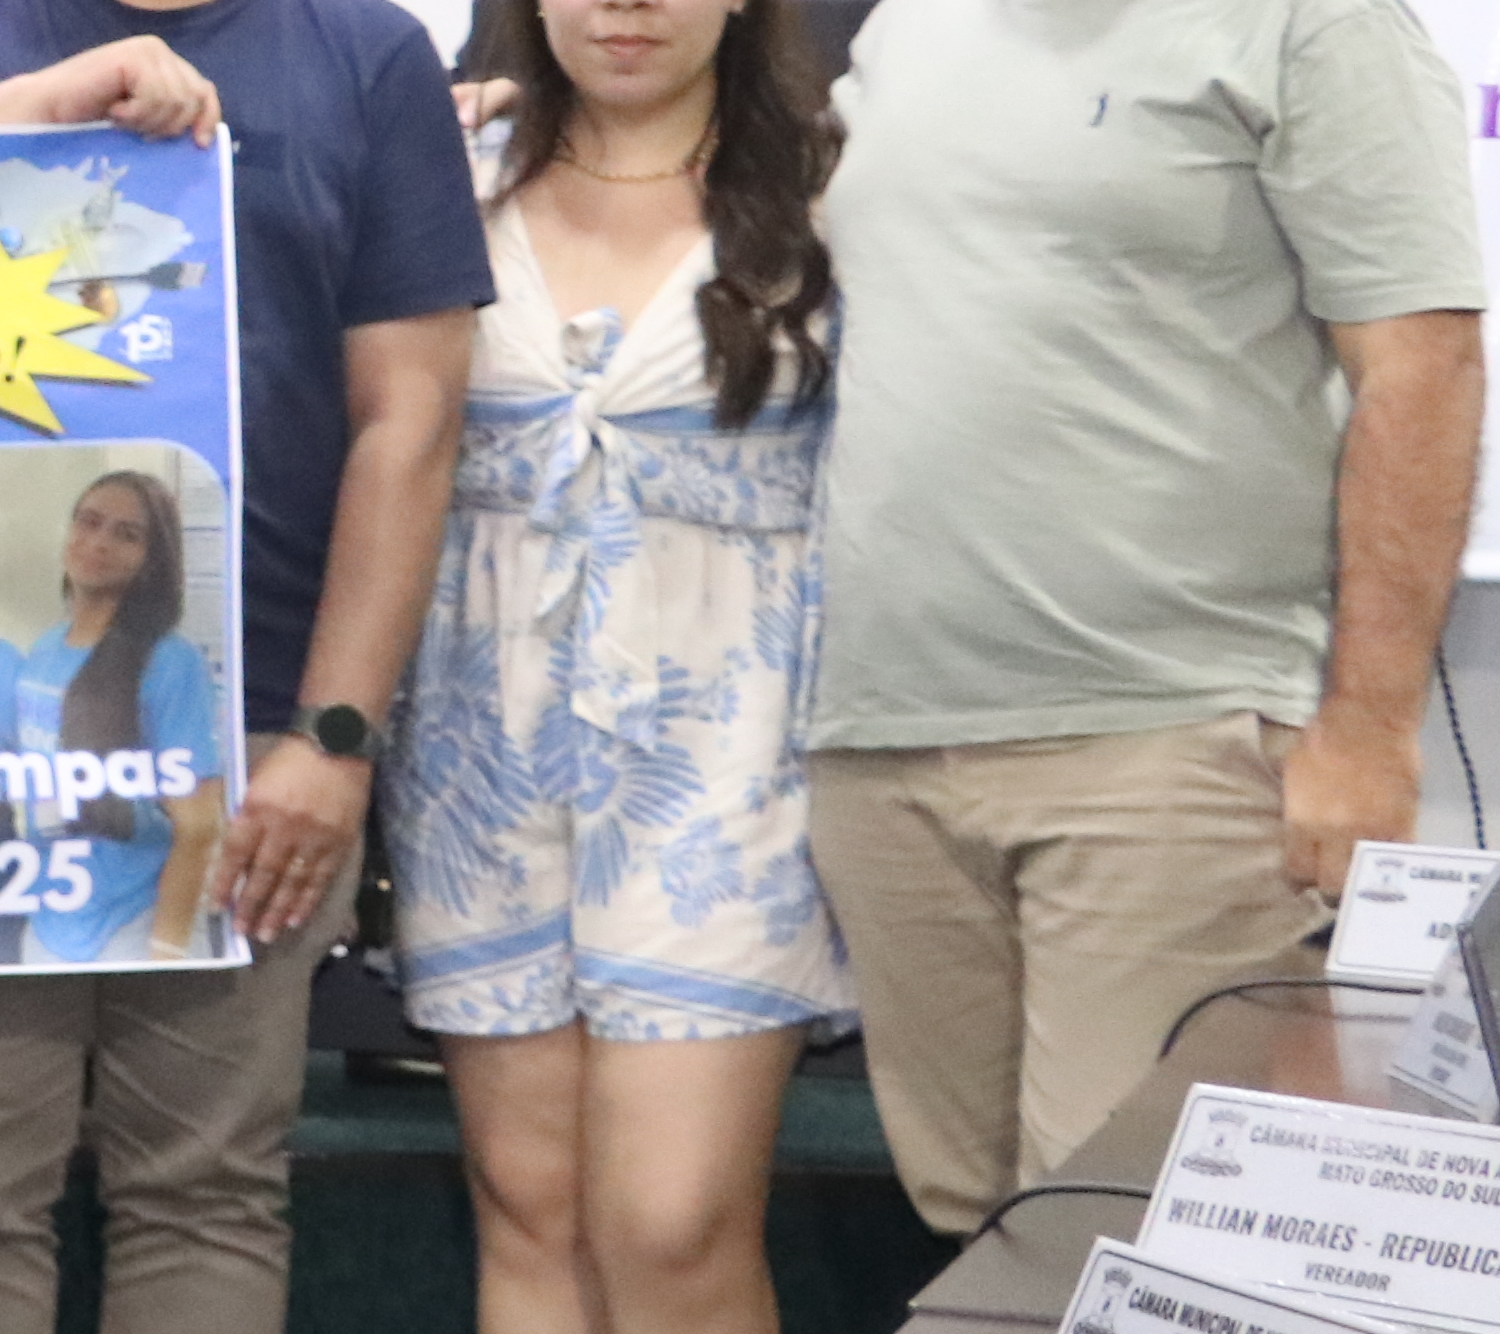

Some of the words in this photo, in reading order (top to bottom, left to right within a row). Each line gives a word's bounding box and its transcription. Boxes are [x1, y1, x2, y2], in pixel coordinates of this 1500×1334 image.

[1249, 1124, 1318, 1153] CÂMARA
[1416, 1148, 1441, 1170] DE
[1443, 1152, 1491, 1178] NOVA
[1318, 1160, 1365, 1186] MATO
[1369, 1169, 1439, 1197] GROSSO
[1441, 1178, 1468, 1202] DO
[1167, 1197, 1261, 1237] WILLIAN
[1262, 1213, 1358, 1253] MORAES
[1380, 1231, 1500, 1279] REPUBLIC
[1305, 1261, 1392, 1292] VEREADOR
[1128, 1284, 1179, 1323] CÂMARA
